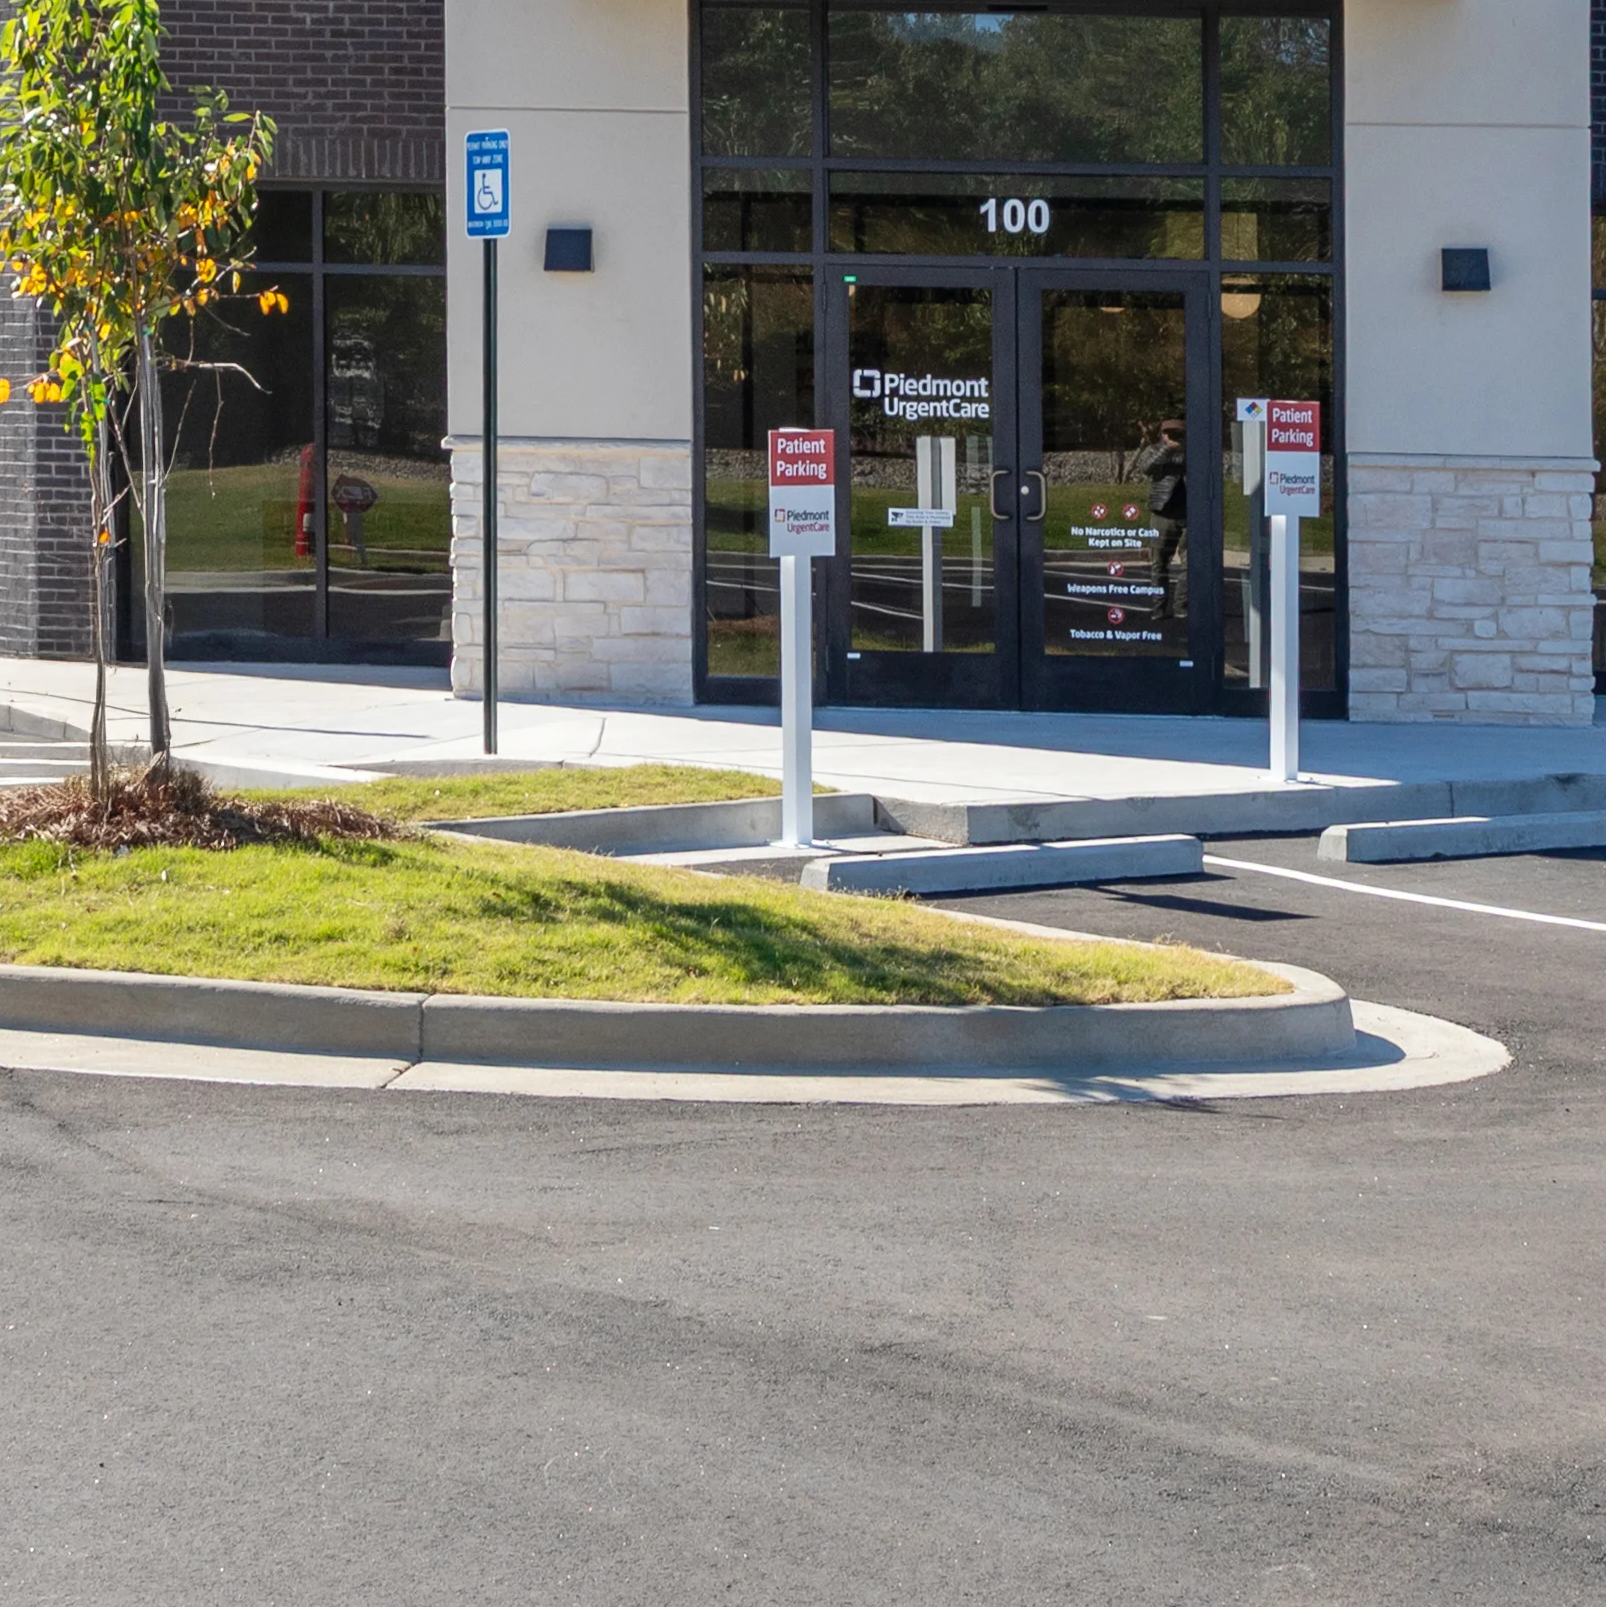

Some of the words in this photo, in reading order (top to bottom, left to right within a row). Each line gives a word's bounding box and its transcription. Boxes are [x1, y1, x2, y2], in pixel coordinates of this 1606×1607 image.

[979, 198, 1050, 233] 100
[884, 373, 989, 397] Piedmont
[884, 397, 989, 420] UrgentCare
[1273, 407, 1312, 423] Patient
[1272, 428, 1313, 447] Parking
[777, 437, 826, 454] Patient
[776, 460, 827, 480] Parking
[1280, 473, 1315, 484] Piedmont
[1280, 485, 1315, 496] UrgentCare
[786, 509, 830, 521] Piedmont
[787, 522, 830, 534] UrgentCare
[1071, 526, 1084, 536] No
[1085, 527, 1126, 537] Narcotics
[1127, 529, 1137, 537] or
[1138, 528, 1159, 537] Cash
[1088, 538, 1110, 548] Kept
[1124, 538, 1142, 548] Site
[1067, 583, 1107, 594] Weapons
[1108, 584, 1128, 594] Free
[1130, 585, 1165, 595] Campus
[1070, 629, 1104, 639] Tobacco
[1106, 630, 1113, 639] &
[1114, 630, 1141, 640] Vapor
[1142, 631, 1162, 640] Free
